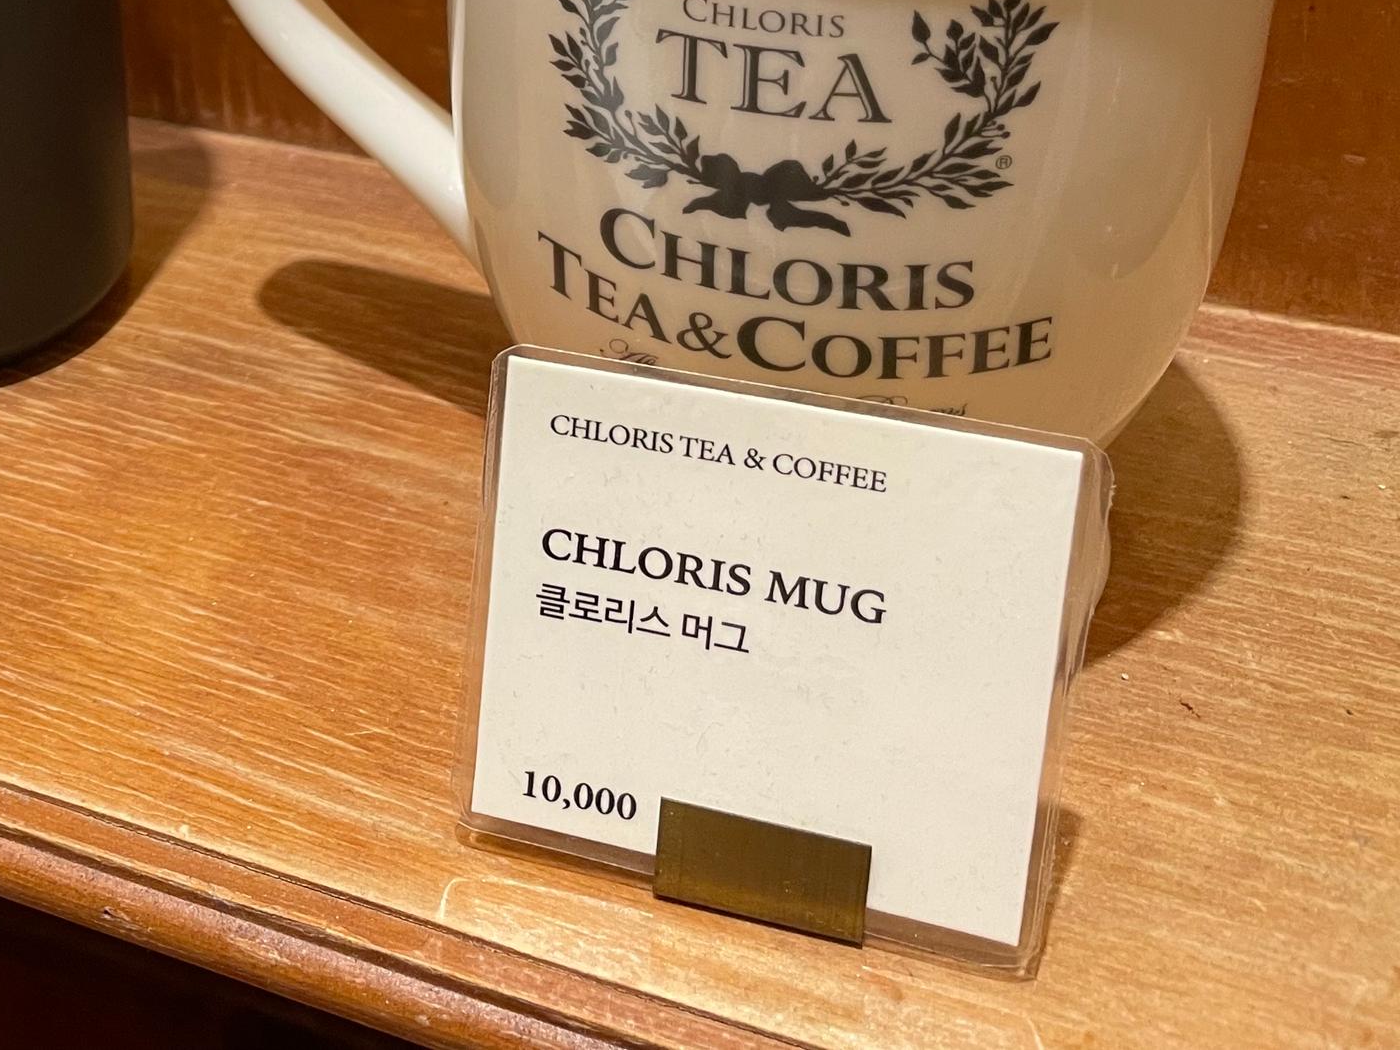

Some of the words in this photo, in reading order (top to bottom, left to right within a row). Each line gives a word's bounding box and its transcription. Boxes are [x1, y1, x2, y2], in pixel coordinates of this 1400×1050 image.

[655, 28, 892, 124] TEA
[537, 230, 1054, 381] TEA&COFFEE
[599, 207, 976, 312] CHLORIS
[549, 414, 674, 455] CHLORIS
[680, 435, 735, 467] TEA
[743, 447, 767, 471] &
[772, 453, 887, 493] COFFEE
[535, 582, 671, 638] 클로리스
[681, 614, 750, 654] 머그
[541, 527, 752, 596] CHLORIS
[764, 570, 887, 625] MUG
[521, 770, 638, 821] 10,000
